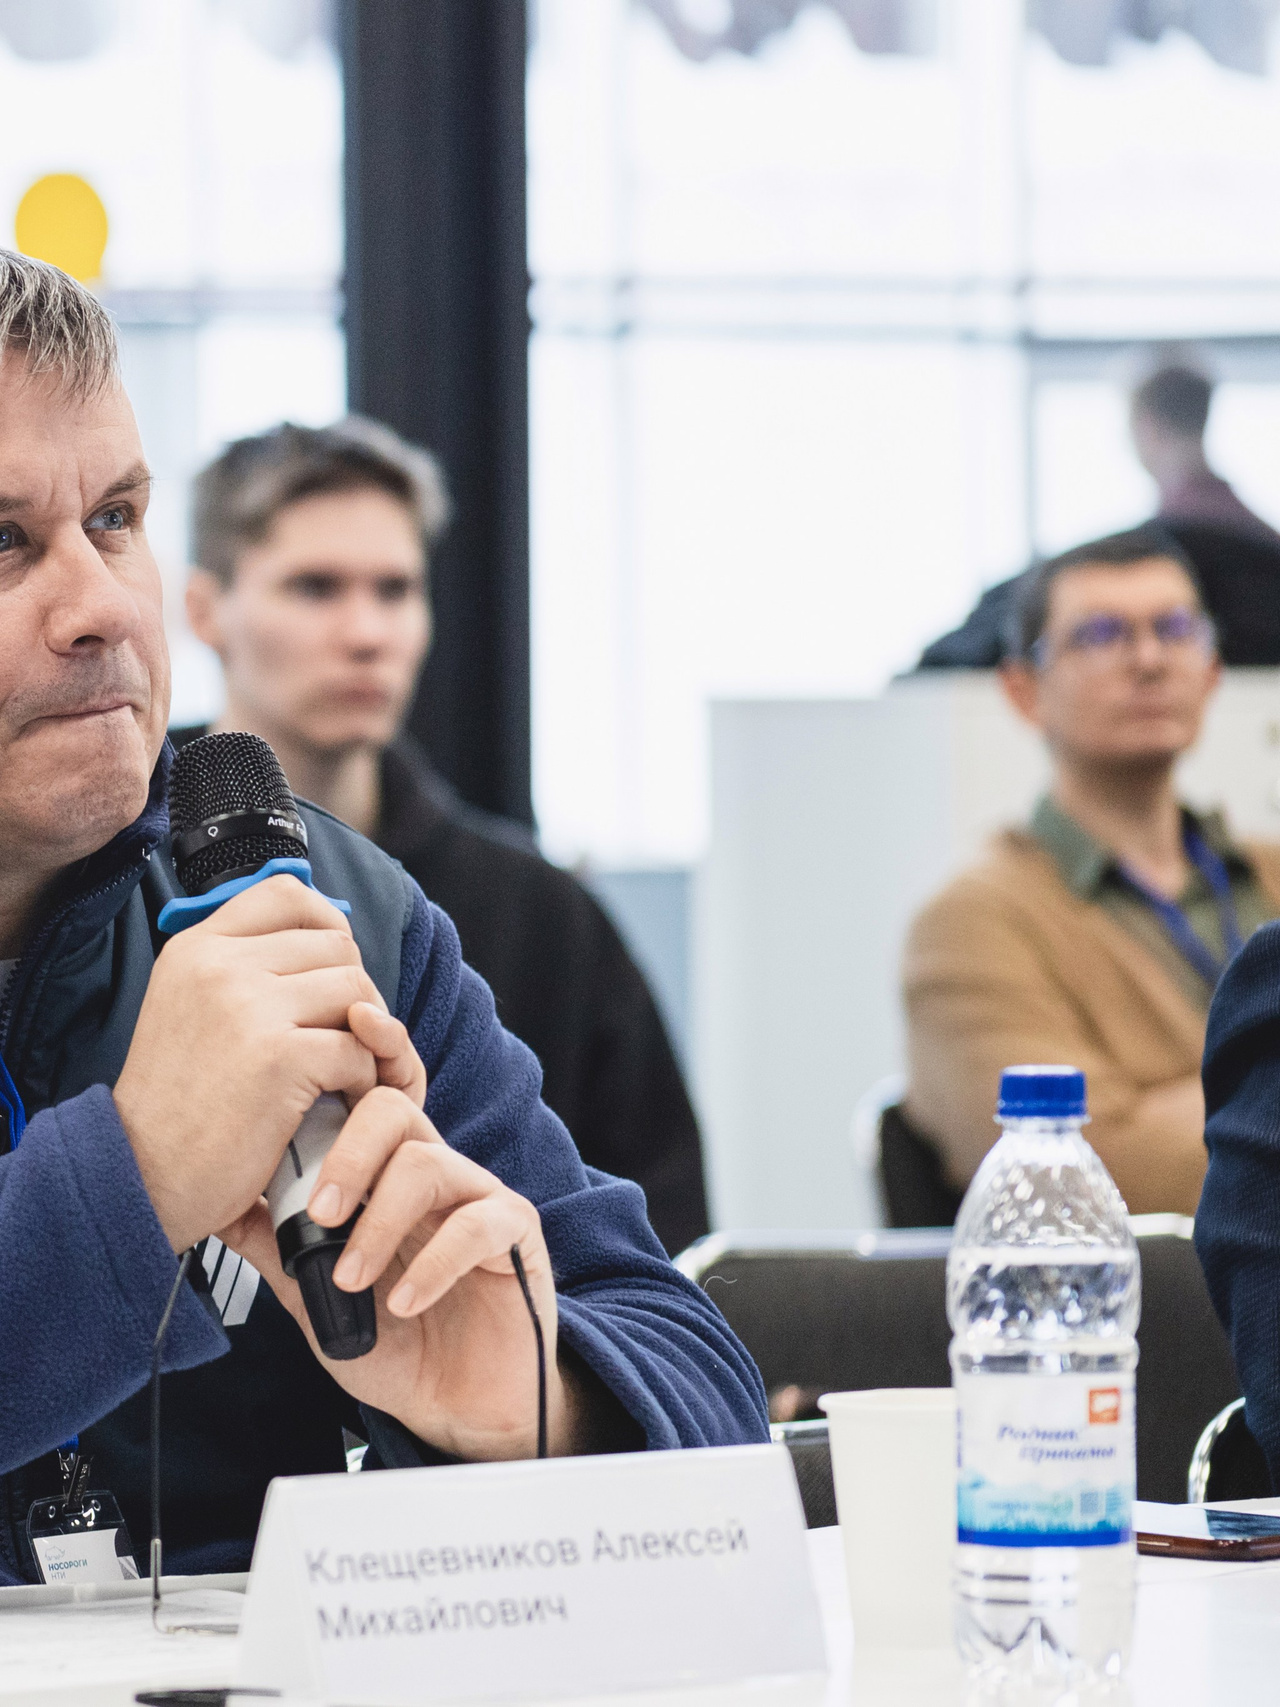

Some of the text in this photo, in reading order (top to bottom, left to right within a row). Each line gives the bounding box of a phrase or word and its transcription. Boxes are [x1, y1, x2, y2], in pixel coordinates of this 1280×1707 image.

[267, 816, 294, 829] Arthur
[305, 1520, 750, 1585] Клещевников Алексей
[48, 1559, 88, 1571] НОСОРОГИ
[51, 1571, 66, 1580] НТИ
[317, 1594, 569, 1641] Михайлович
